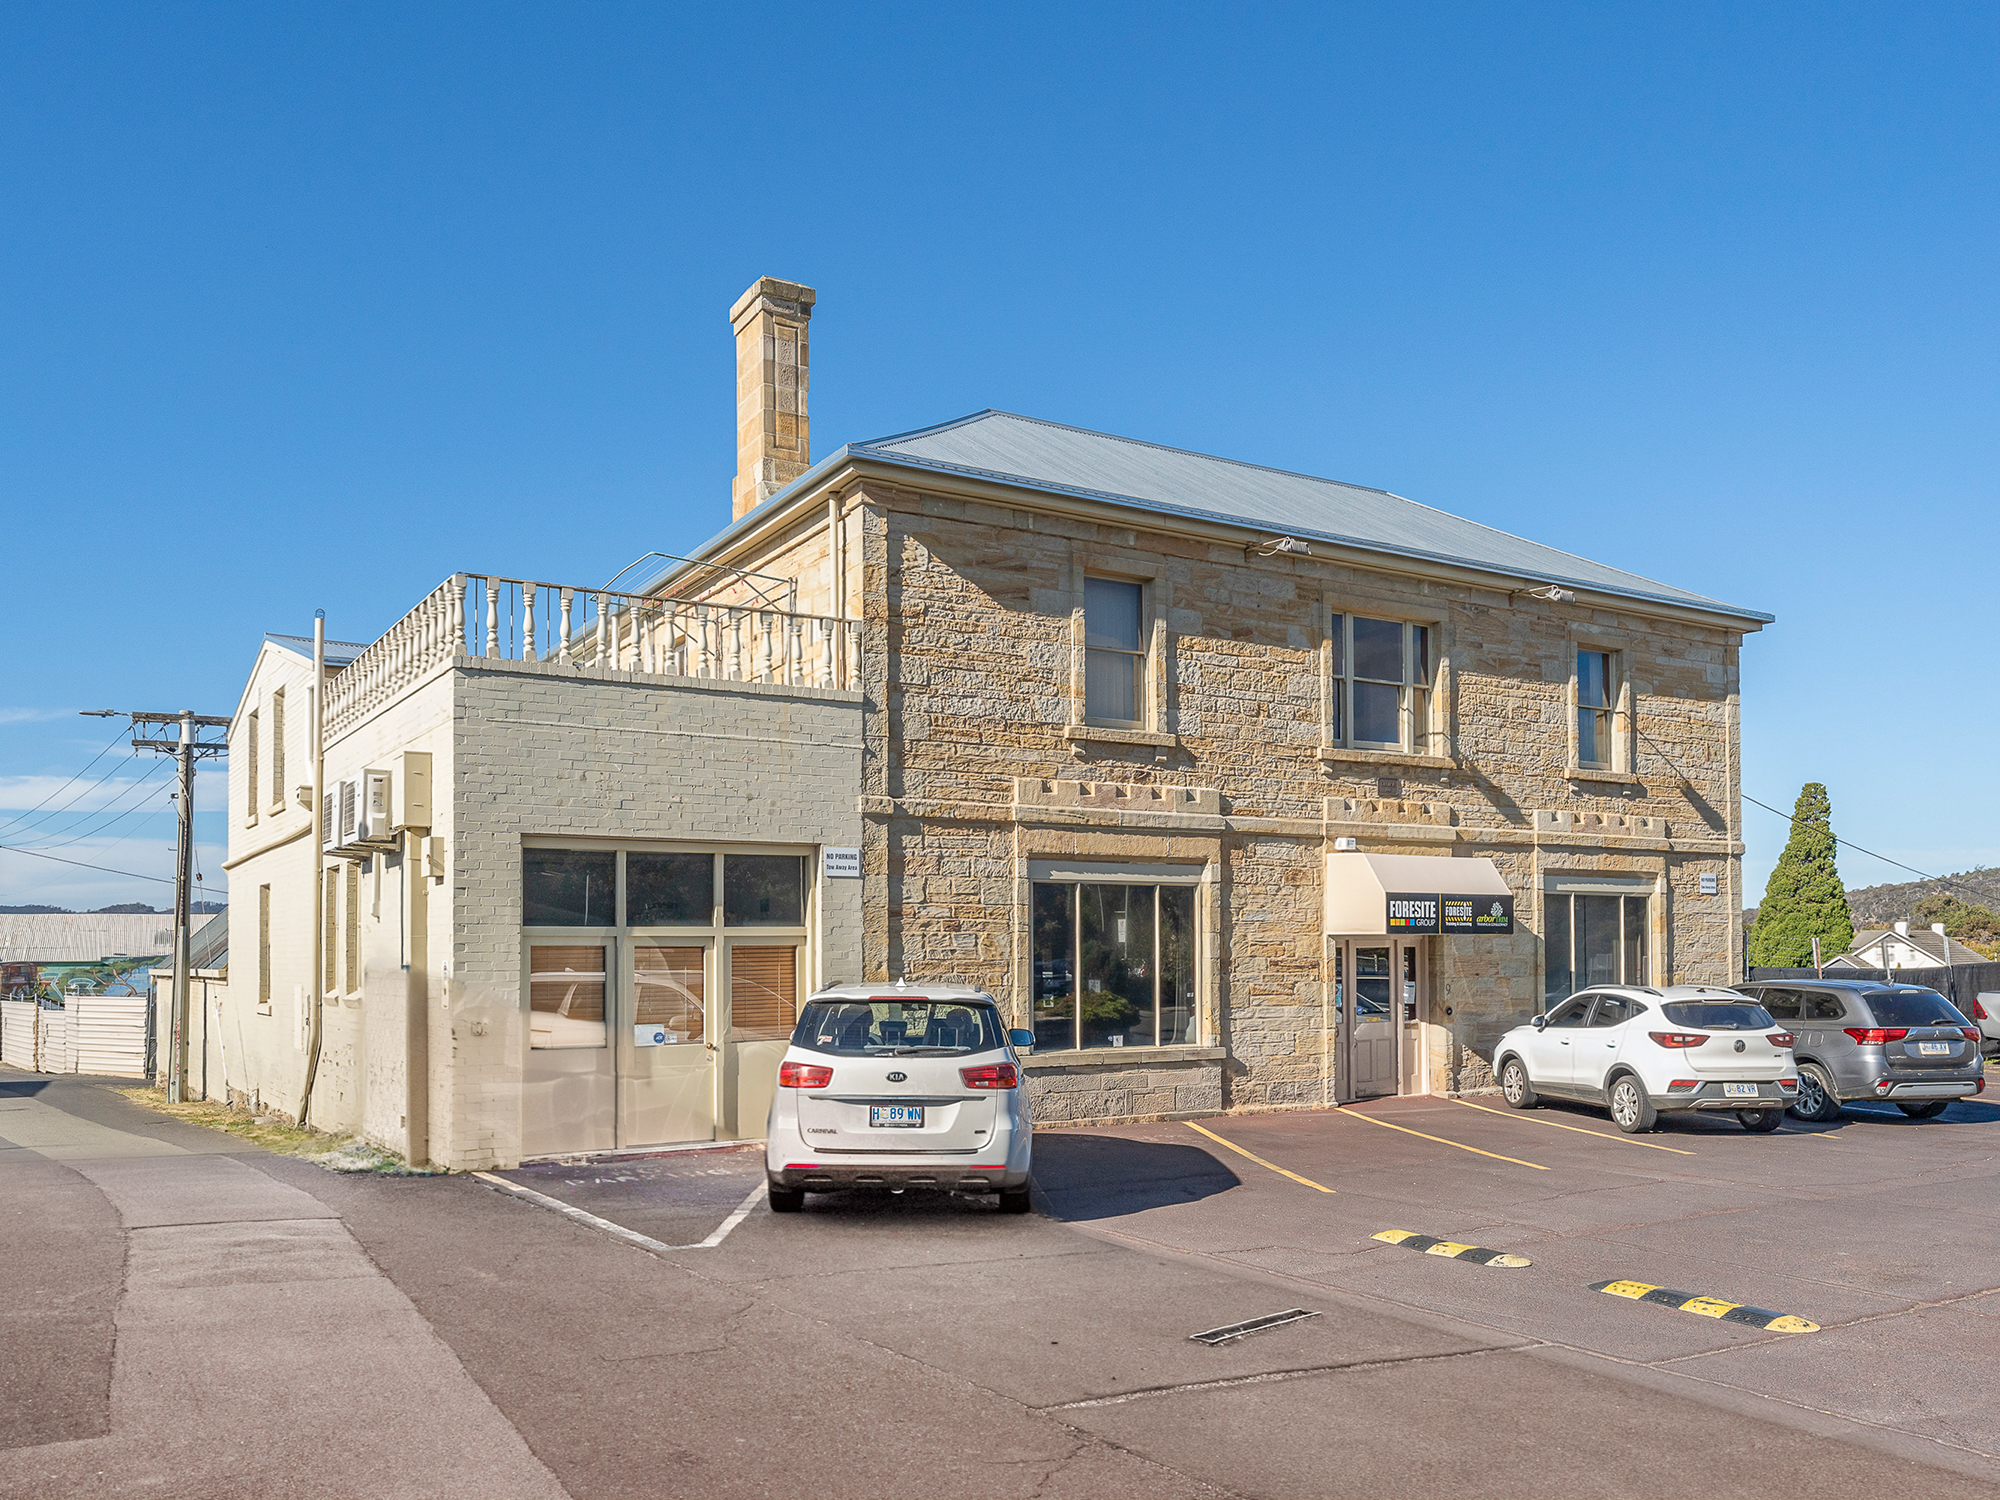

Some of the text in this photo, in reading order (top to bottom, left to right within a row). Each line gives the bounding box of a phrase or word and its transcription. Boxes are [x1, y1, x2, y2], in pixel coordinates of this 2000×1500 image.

[1390, 900, 1436, 918] FORESITE
[1416, 918, 1436, 927] GROUP
[1445, 983, 1451, 996] 9
[1727, 1084, 1756, 1092] J 82 VR
[872, 1108, 921, 1119] H 89 WN
